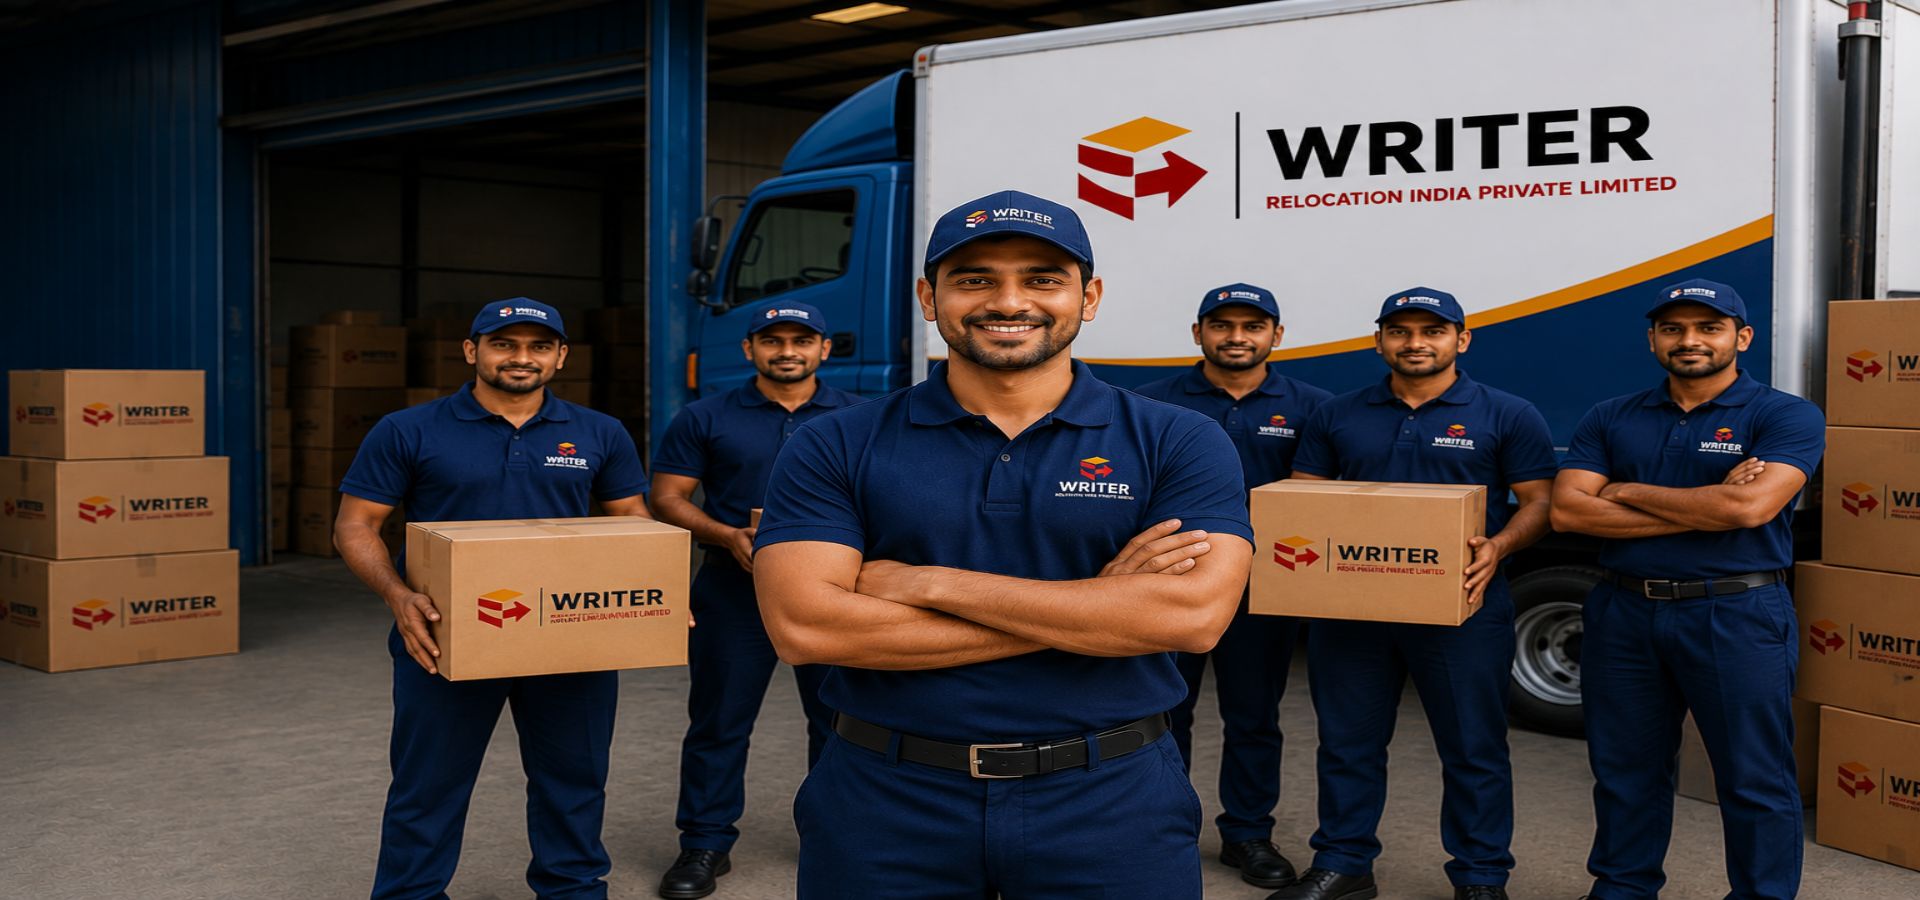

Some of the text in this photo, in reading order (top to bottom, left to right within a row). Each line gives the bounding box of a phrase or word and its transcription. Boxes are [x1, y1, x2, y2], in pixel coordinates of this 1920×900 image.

[1266, 105, 1653, 181] WRITER
[1266, 176, 1677, 210] RELOCATION INDIA PRIVATE LIMITED
[992, 208, 1053, 224] WRITER
[124, 405, 191, 417] WRITER
[1700, 441, 1743, 452] WRITER
[545, 455, 587, 466] WRITER
[1059, 481, 1130, 495] WRITER
[129, 496, 209, 512] WRITER
[1337, 544, 1440, 565] WRITER
[130, 595, 217, 615] WRITER
[550, 588, 664, 611] WRITER
